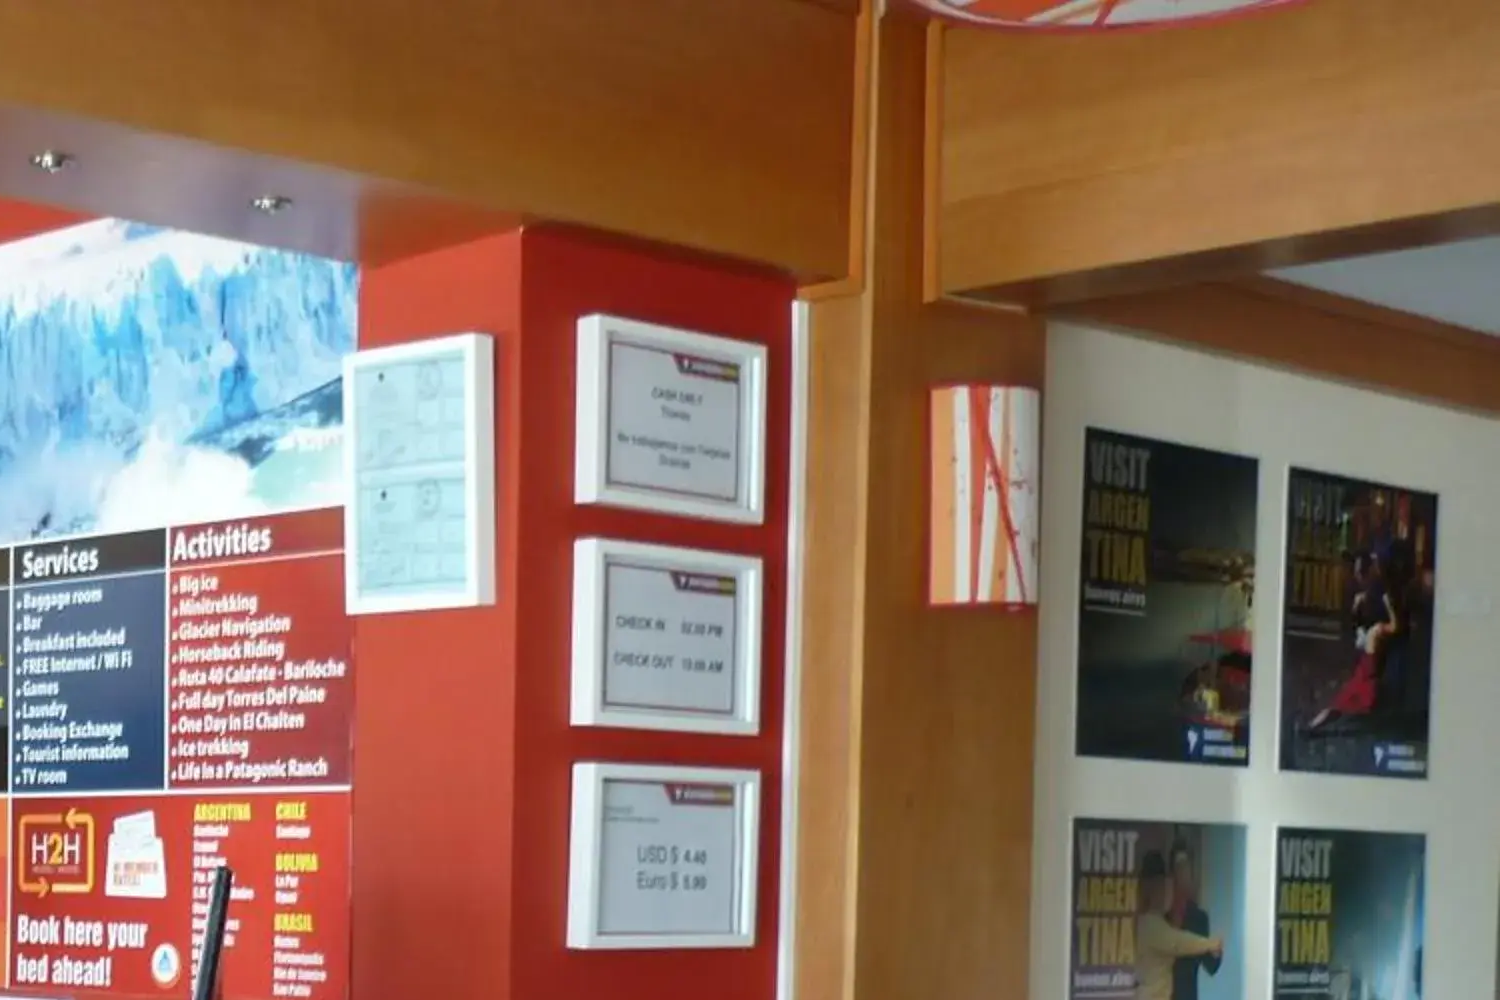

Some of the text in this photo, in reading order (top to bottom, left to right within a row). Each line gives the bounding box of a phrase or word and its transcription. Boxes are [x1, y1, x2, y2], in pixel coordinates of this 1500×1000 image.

[1089, 440, 1150, 492] VISIT
[173, 523, 272, 561] Activities
[23, 545, 99, 578] Services
[1086, 528, 1147, 588] TINA
[179, 576, 198, 596] Big
[23, 589, 103, 612] Baggage room
[23, 615, 42, 631] Bar
[179, 614, 291, 640] Glacier Navigation
[616, 615, 651, 630] CHECK
[23, 627, 126, 653] Breakfast included
[179, 638, 285, 663] Horseback Riding
[22, 655, 49, 674] FREE
[51, 653, 96, 673] Internet
[613, 651, 649, 667] CHECK
[179, 658, 345, 687] Ruta 40 Calafate Bariloche
[23, 681, 59, 697] Games
[179, 686, 326, 712] Full day Torres Del Paine
[23, 701, 68, 721] Laundry
[178, 716, 202, 733] One
[204, 715, 227, 736] Day
[243, 712, 254, 731] El
[256, 711, 305, 730] Chalten
[23, 721, 123, 744] Booking Exchange
[22, 743, 129, 763] Tourist information
[178, 737, 249, 759] Ice trekking
[22, 768, 67, 785] TV room
[178, 761, 200, 781] Life
[215, 765, 224, 779] a
[225, 759, 287, 783] Patagonic
[288, 756, 328, 777] Ranch
[31, 832, 81, 865] H2H
[637, 845, 667, 864] USD
[1077, 829, 1139, 874] VISIT
[1280, 837, 1333, 879] VISIT
[636, 870, 667, 890] Euro
[1077, 874, 1138, 914] ARGEN
[1279, 881, 1333, 915] ARGEN
[16, 913, 148, 952] Book here your
[1077, 916, 1135, 966] TINA
[1279, 919, 1331, 965] TINA
[16, 952, 113, 988] bed ahead!
